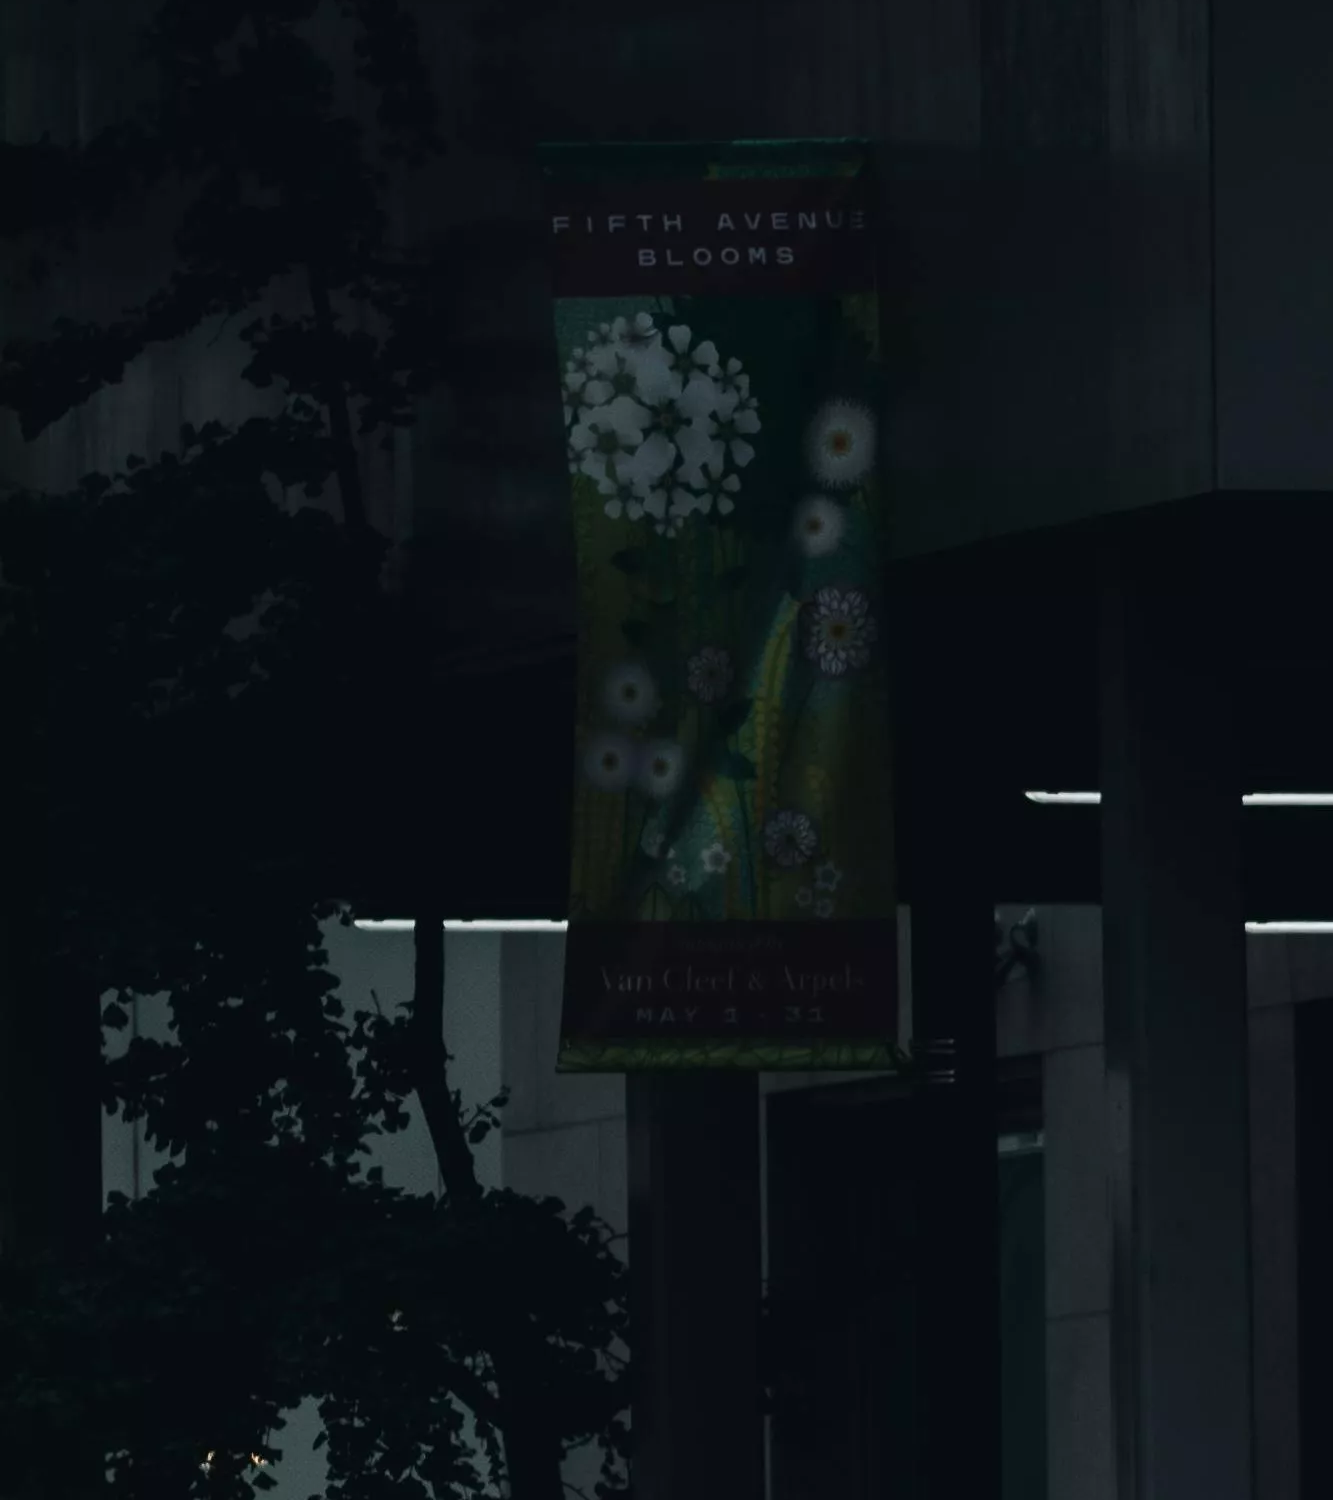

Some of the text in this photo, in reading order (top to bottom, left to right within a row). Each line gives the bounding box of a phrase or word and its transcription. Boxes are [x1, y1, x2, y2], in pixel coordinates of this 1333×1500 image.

[551, 210, 866, 234] FIFTH AVENUE
[636, 245, 795, 268] BLOOMS
[635, 1005, 700, 1024] MAY
